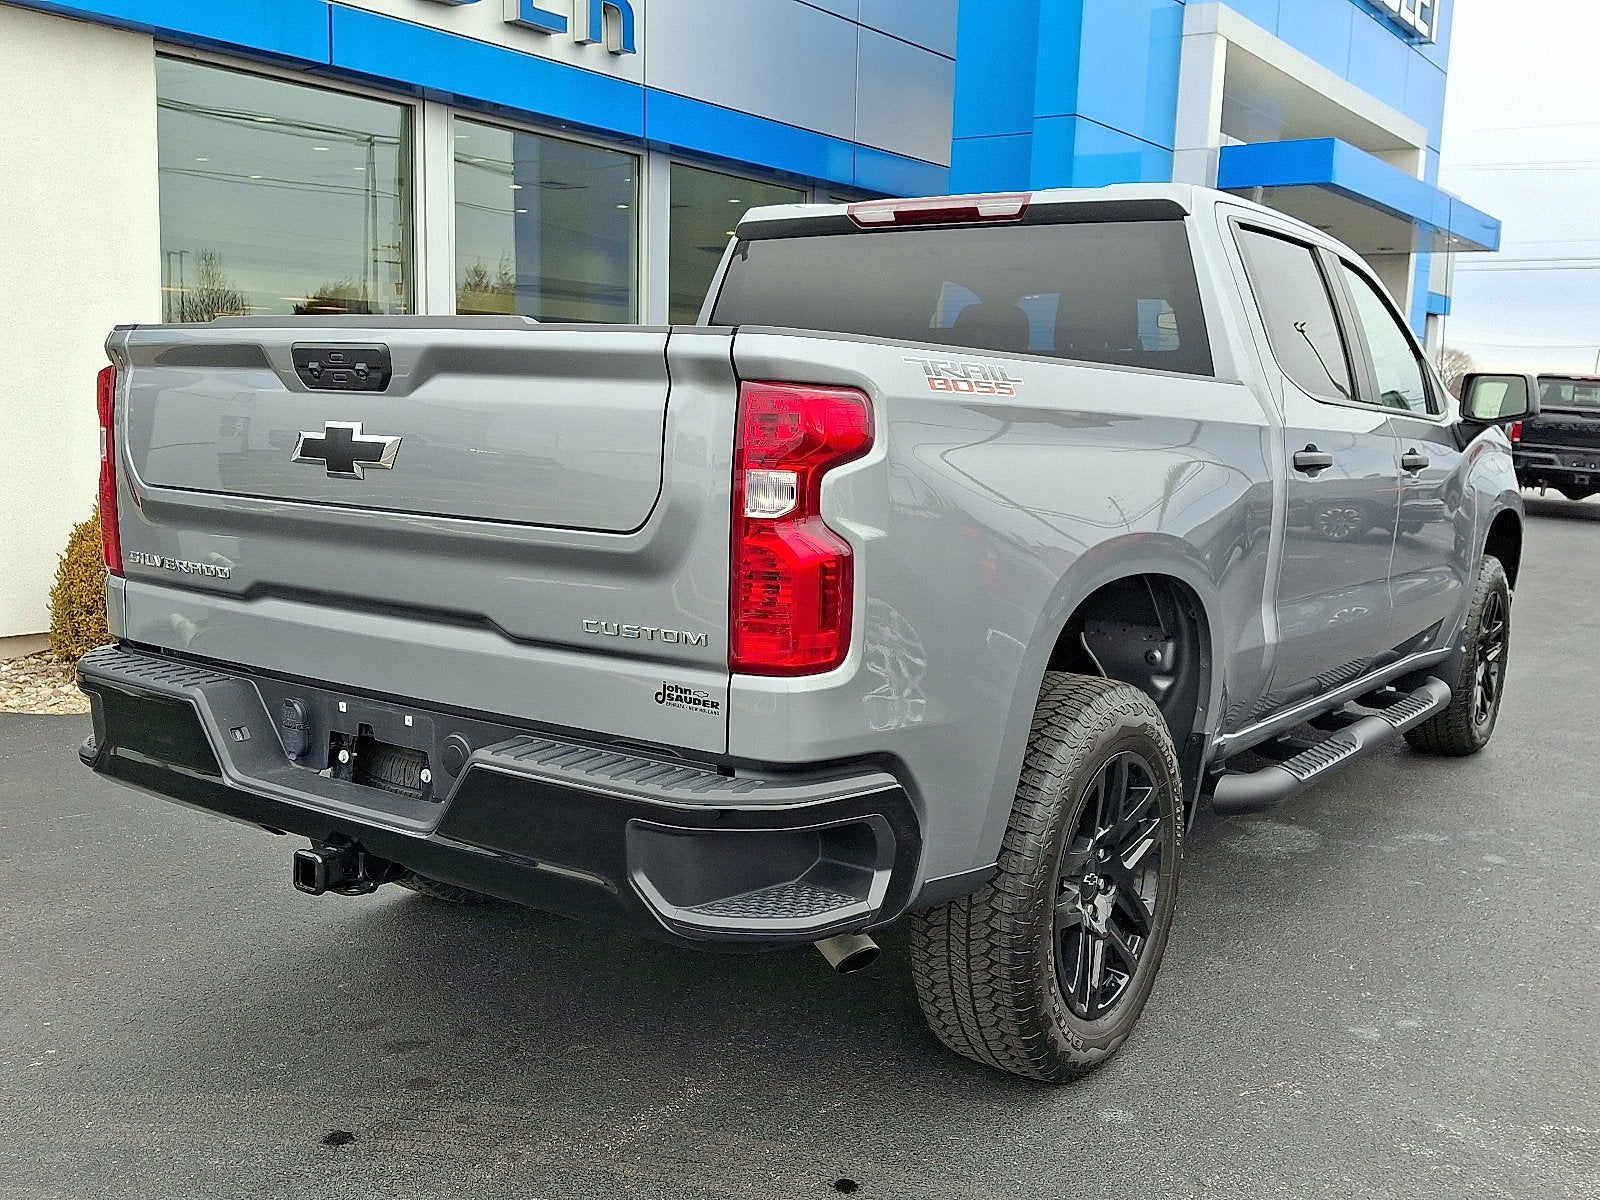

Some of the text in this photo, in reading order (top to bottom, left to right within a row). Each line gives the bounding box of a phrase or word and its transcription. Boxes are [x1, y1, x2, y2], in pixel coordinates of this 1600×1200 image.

[901, 356, 1024, 385] TRAIL
[926, 376, 1016, 397] BOSS
[129, 551, 231, 579] SILVERADO
[582, 619, 708, 647] CUSTOM
[666, 692, 720, 710] SAUDER
